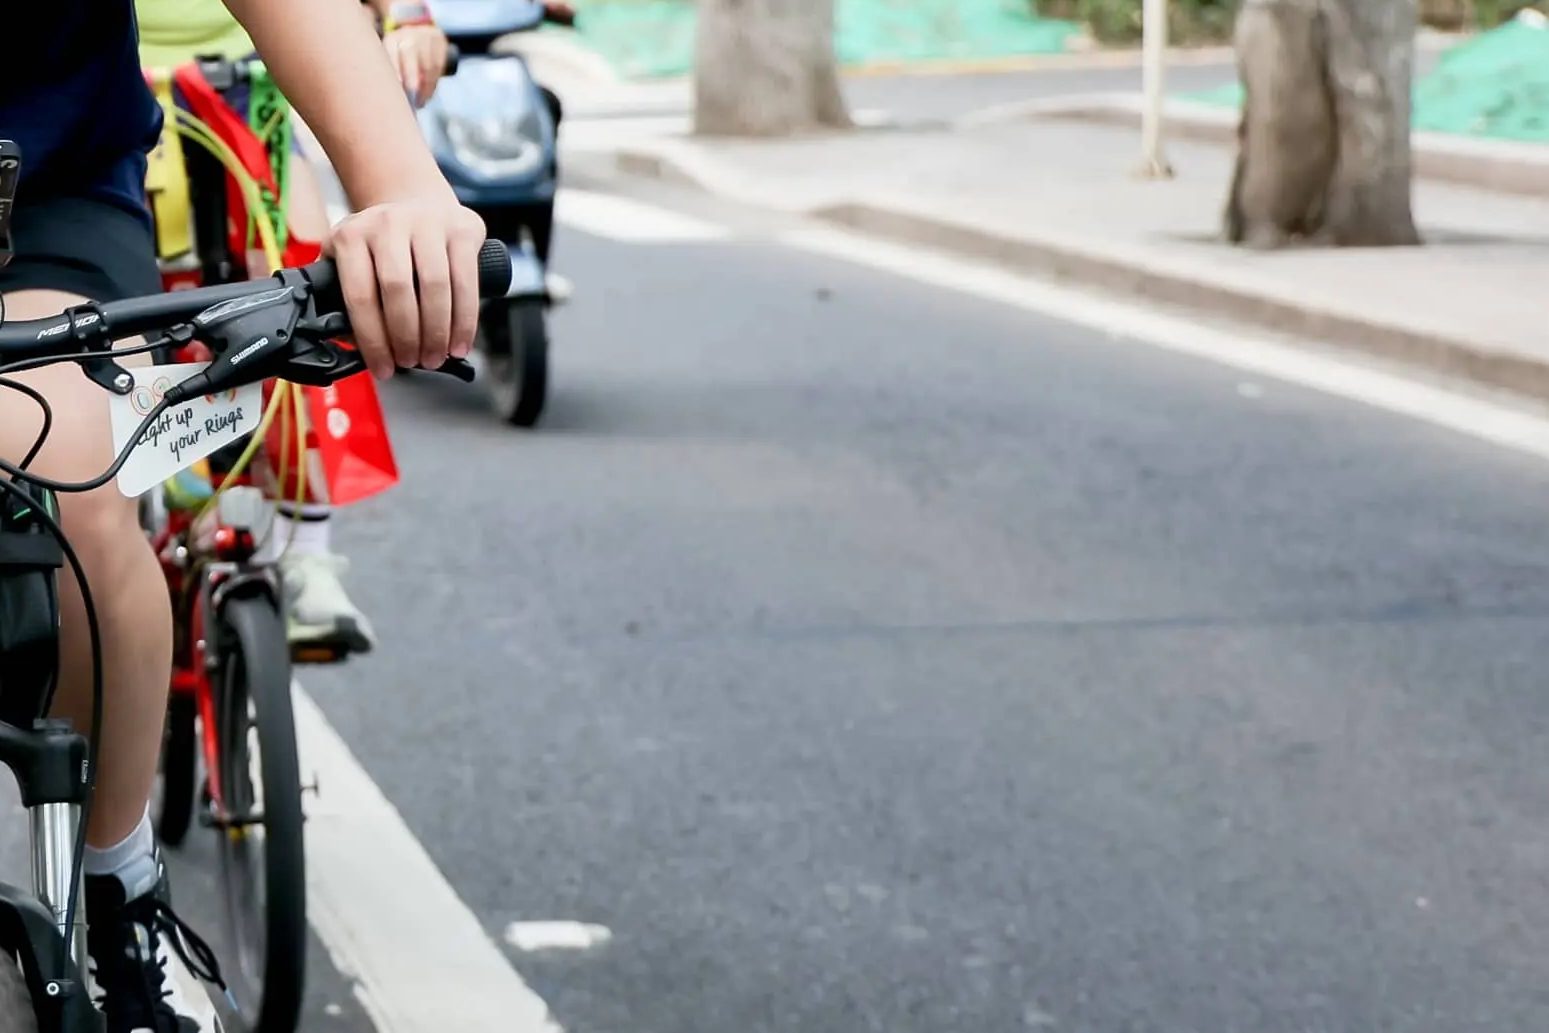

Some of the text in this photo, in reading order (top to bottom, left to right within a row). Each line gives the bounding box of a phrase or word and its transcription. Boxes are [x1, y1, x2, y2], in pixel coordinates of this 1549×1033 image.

[230, 337, 269, 365] SHIMANO
[176, 407, 194, 428] up
[170, 407, 244, 462] your Rings
